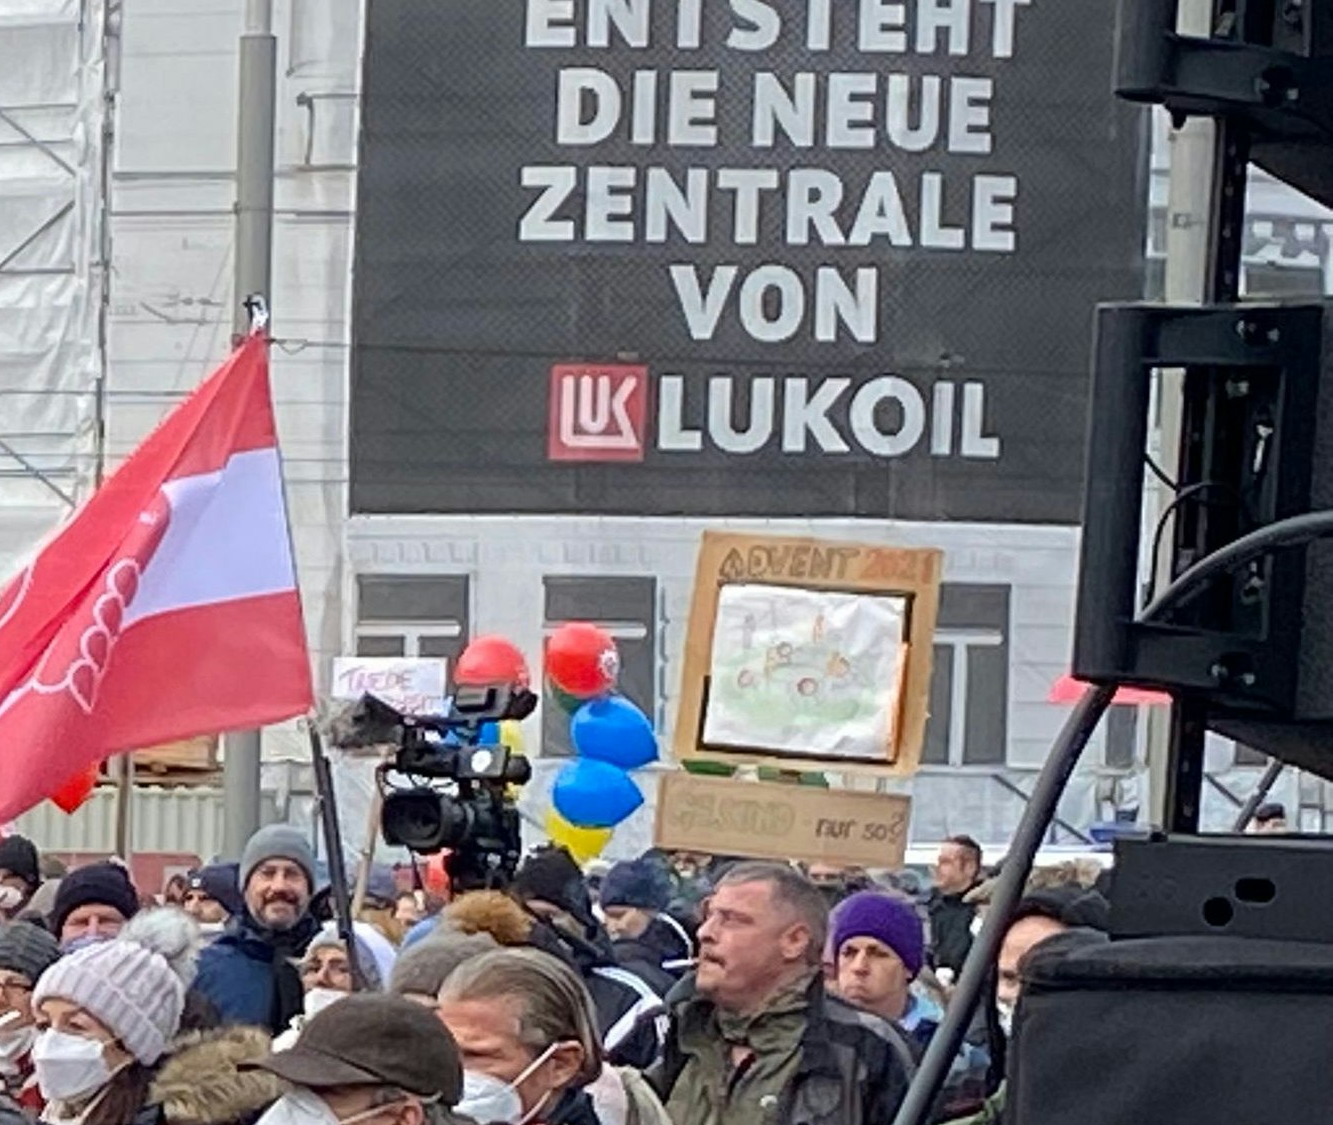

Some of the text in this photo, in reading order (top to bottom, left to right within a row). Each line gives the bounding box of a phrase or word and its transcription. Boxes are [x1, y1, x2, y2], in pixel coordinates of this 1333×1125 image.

[525, 0, 1030, 57] ENTSTEHT
[557, 68, 993, 153] DIE NEUE
[519, 167, 1018, 251] ZENTRALE
[670, 265, 878, 343] VON
[658, 375, 1000, 458] LUKOIL
[719, 545, 860, 580] ADVENT
[815, 817, 855, 838] nur
